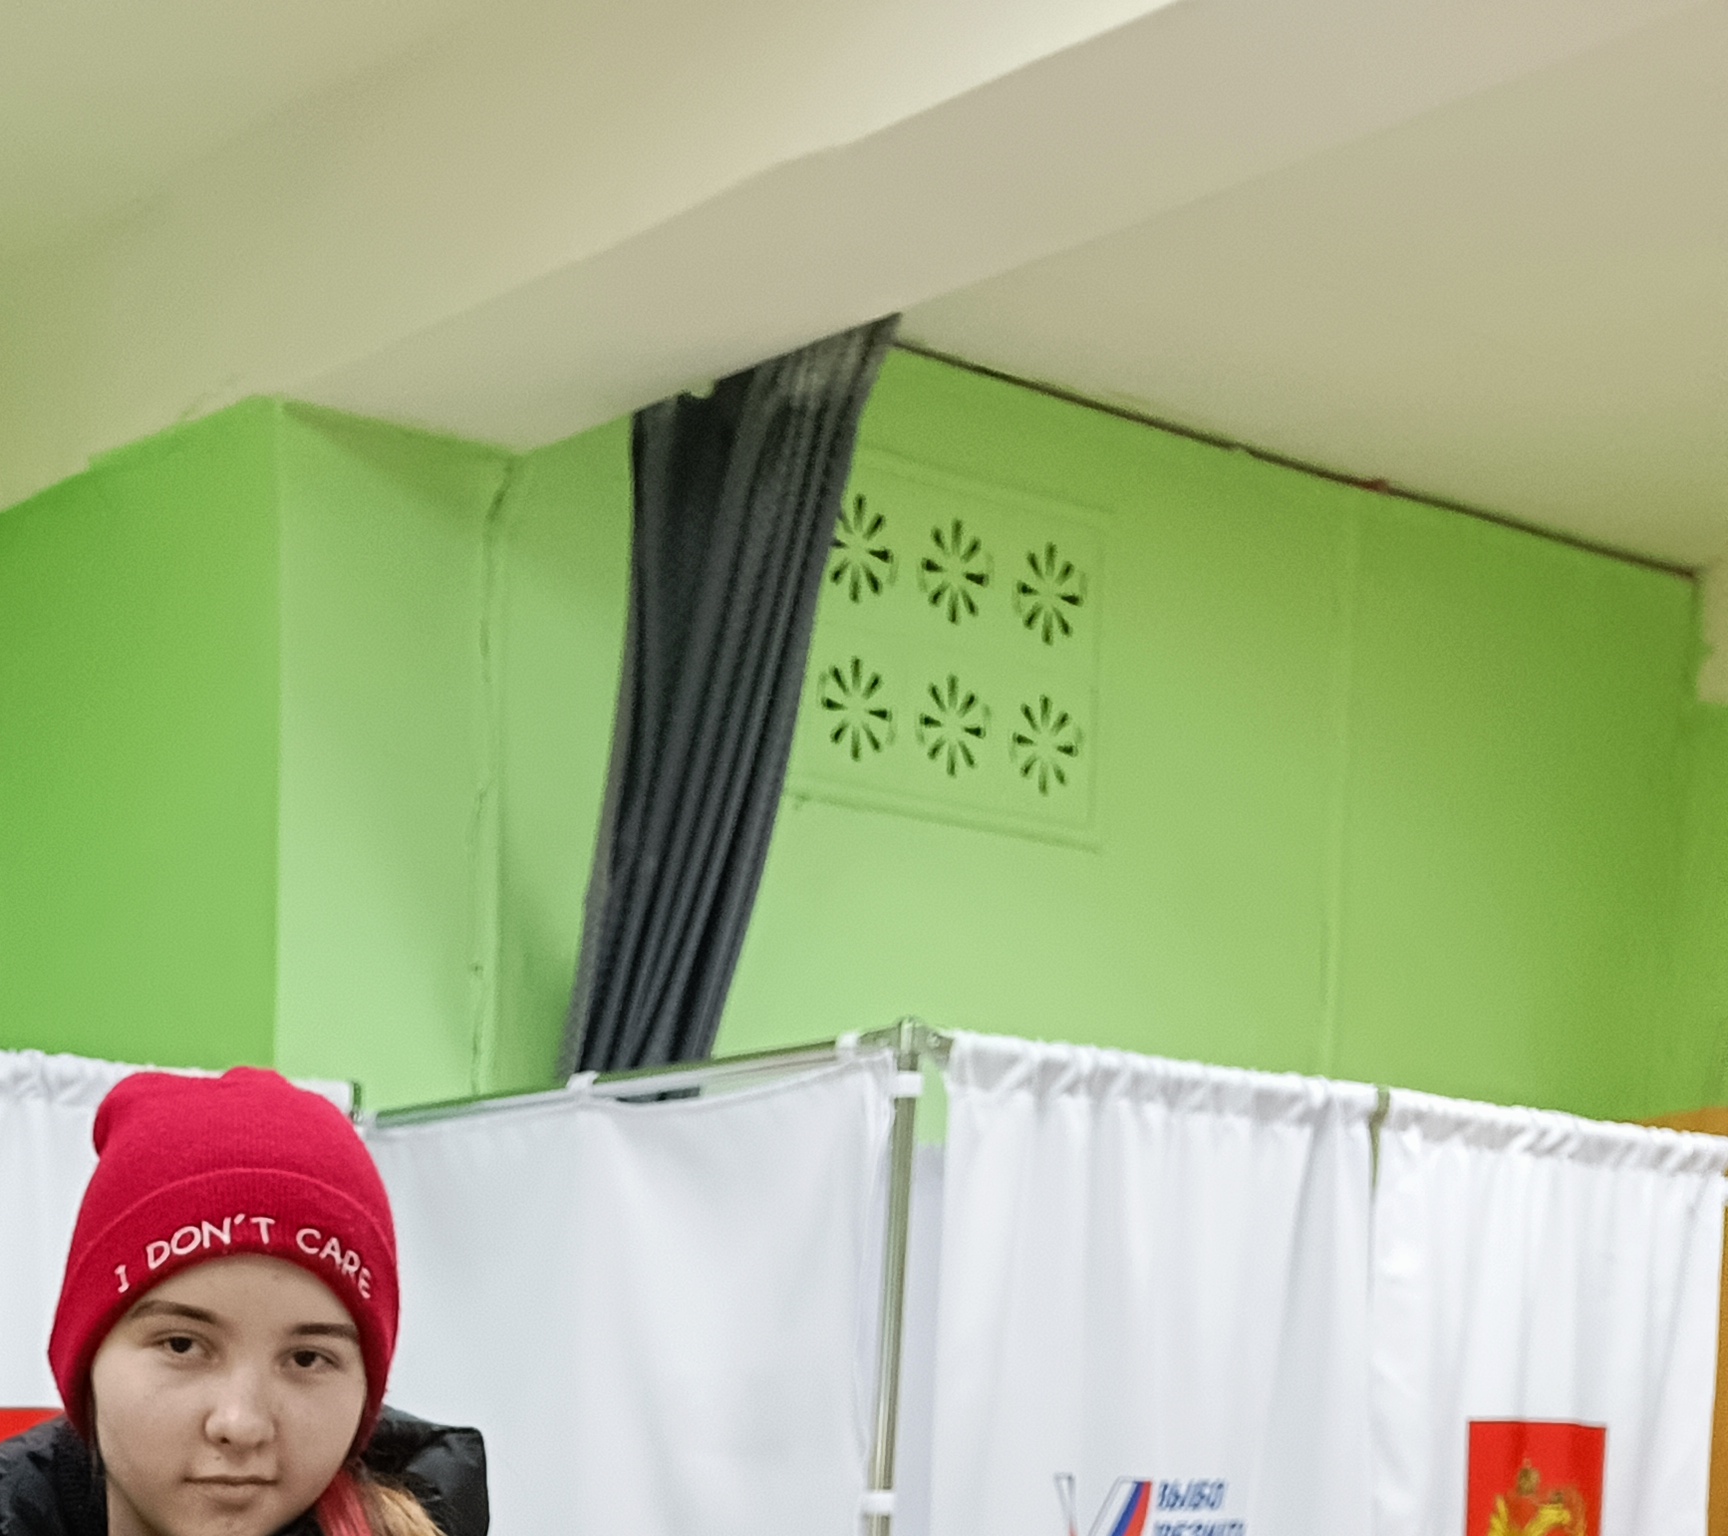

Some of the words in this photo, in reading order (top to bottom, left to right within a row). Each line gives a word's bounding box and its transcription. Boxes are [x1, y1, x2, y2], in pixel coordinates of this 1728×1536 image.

[115, 1265, 130, 1293] I
[146, 1214, 275, 1270] DON'T
[296, 1228, 372, 1299] CARE
